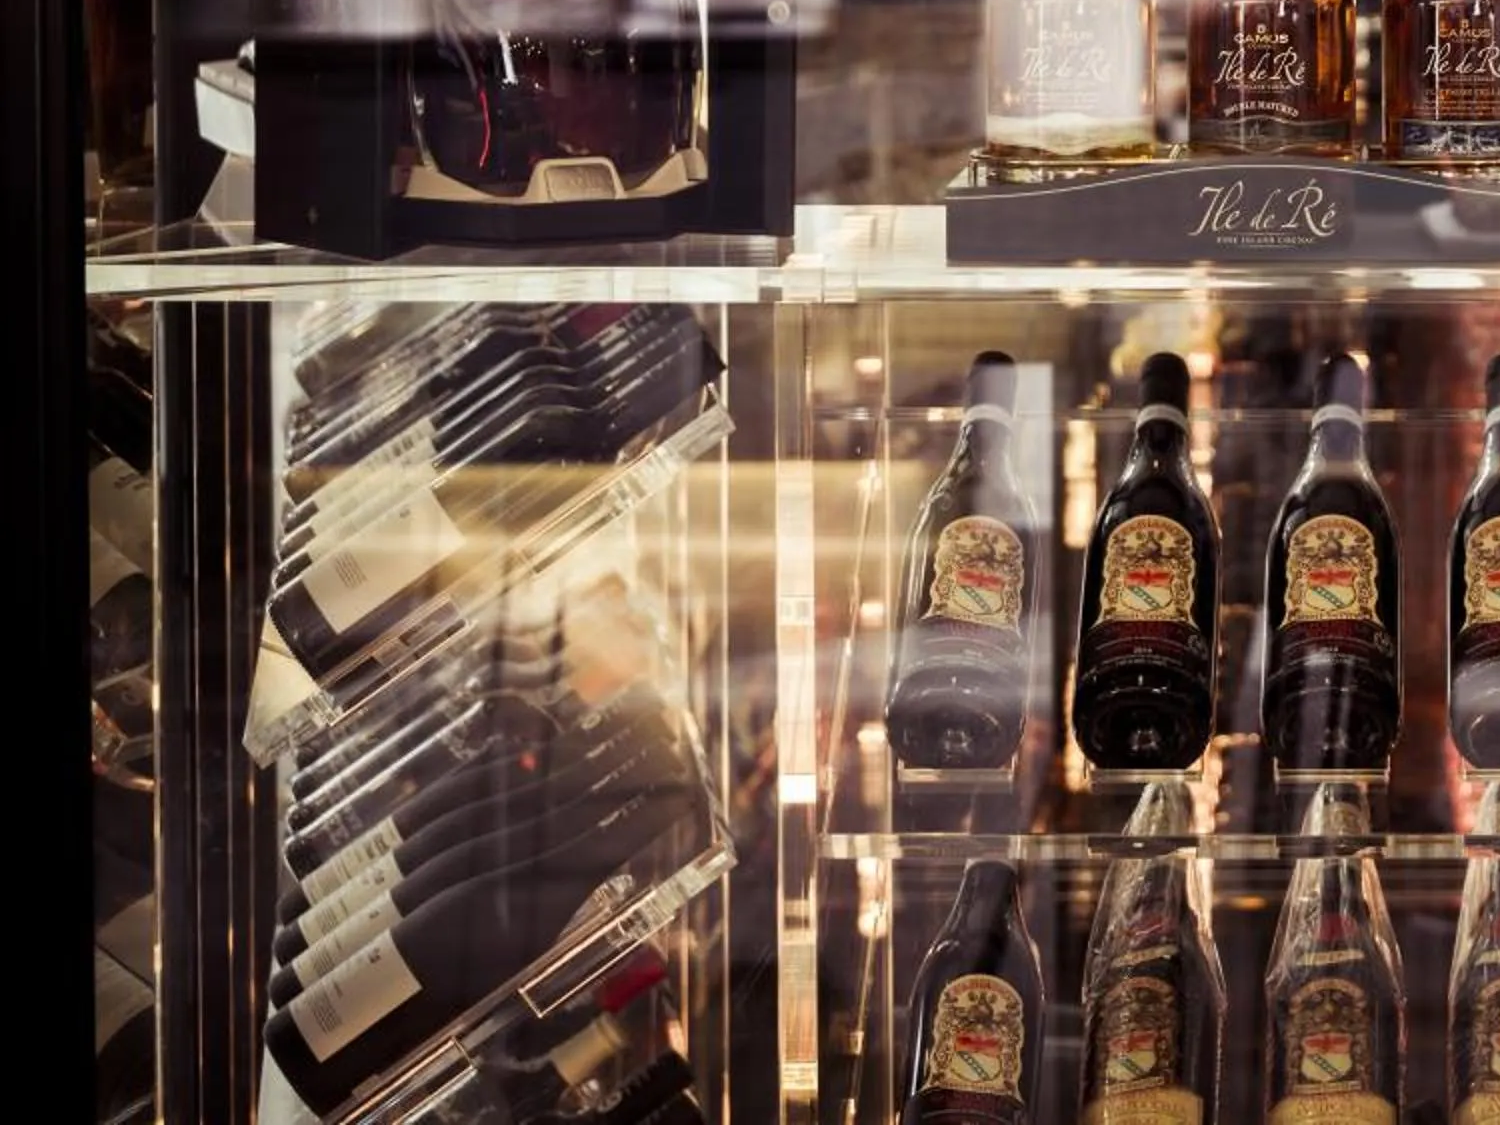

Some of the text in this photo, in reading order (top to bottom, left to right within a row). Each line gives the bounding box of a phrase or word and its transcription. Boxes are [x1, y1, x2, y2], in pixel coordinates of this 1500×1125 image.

[1234, 33, 1289, 44] CAMUS
[1439, 28, 1491, 38] CAMUS
[1249, 52, 1270, 81] de
[1269, 46, 1306, 86] Ré
[1456, 47, 1476, 74] de
[1250, 188, 1281, 230] de
[1281, 178, 1336, 237] Ré
